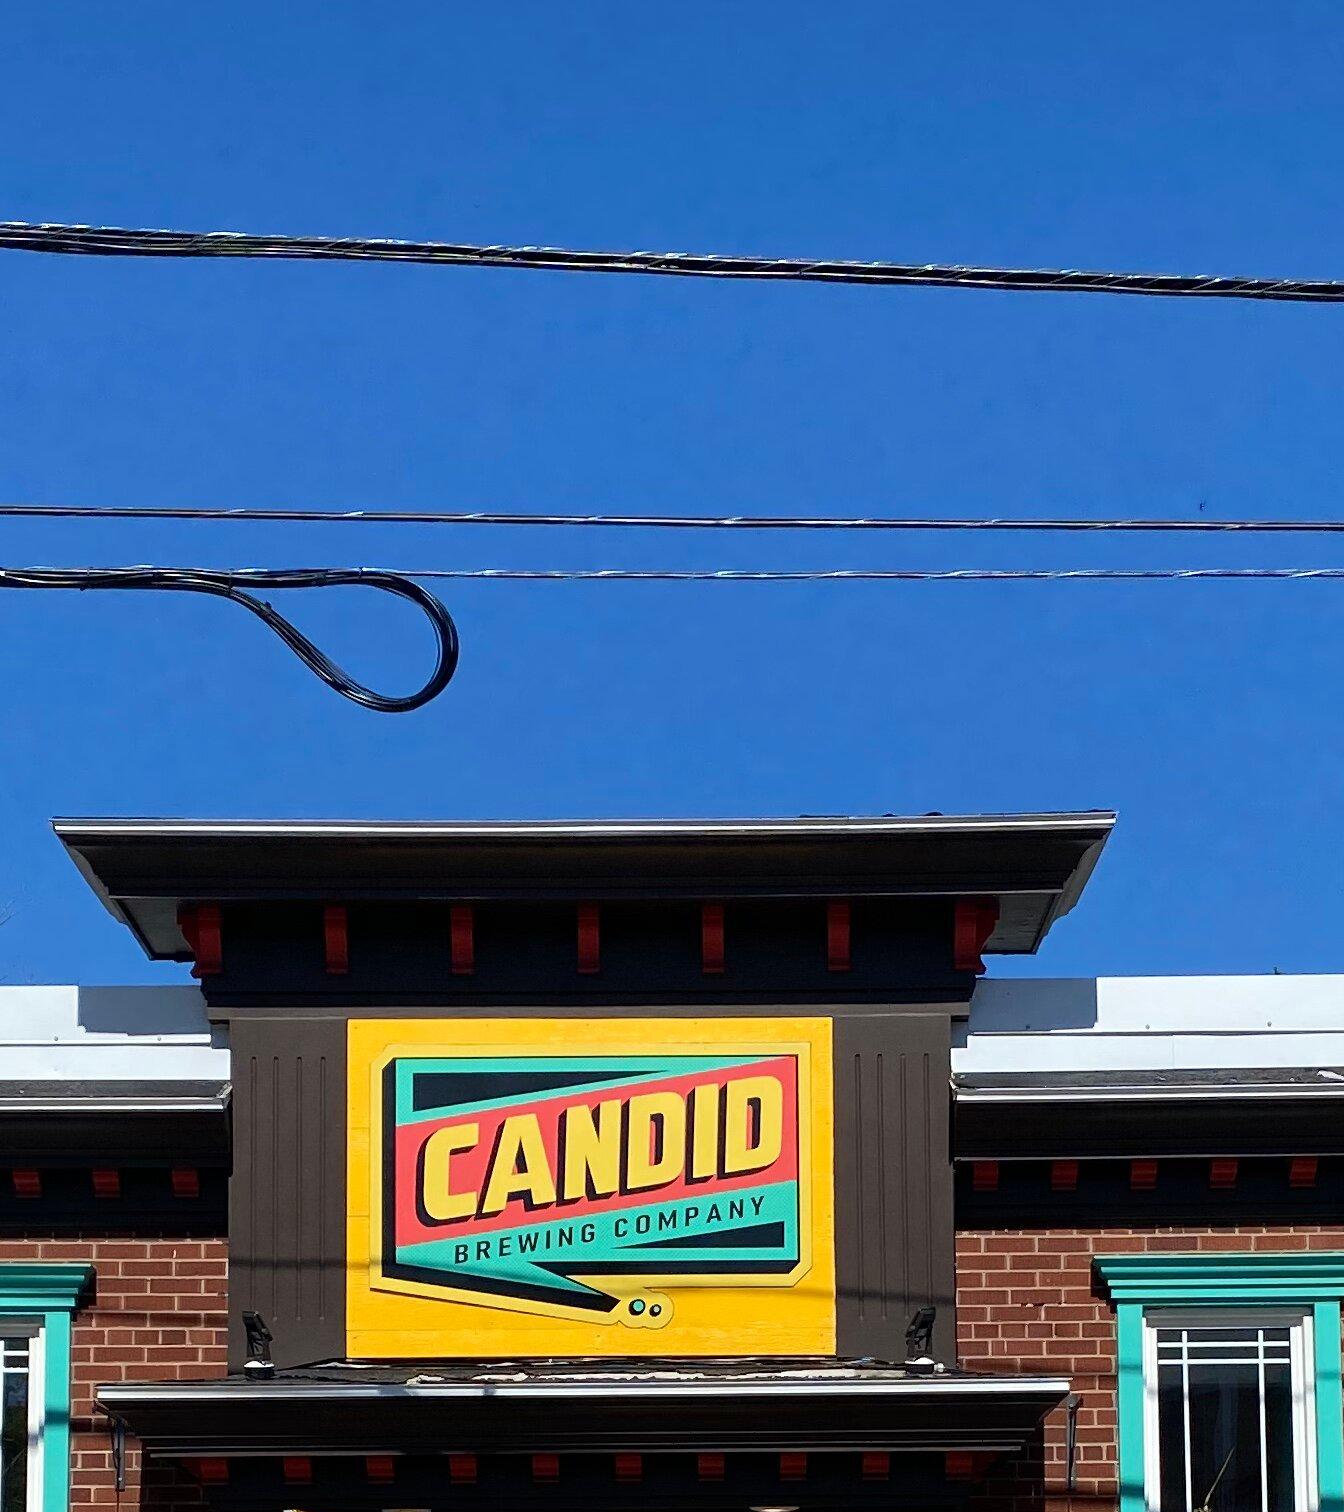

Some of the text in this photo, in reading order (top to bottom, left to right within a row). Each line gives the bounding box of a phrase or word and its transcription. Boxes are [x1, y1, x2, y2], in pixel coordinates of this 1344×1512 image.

[418, 1076, 782, 1226] CANDID
[455, 1196, 766, 1263] BREWING COMPANY
